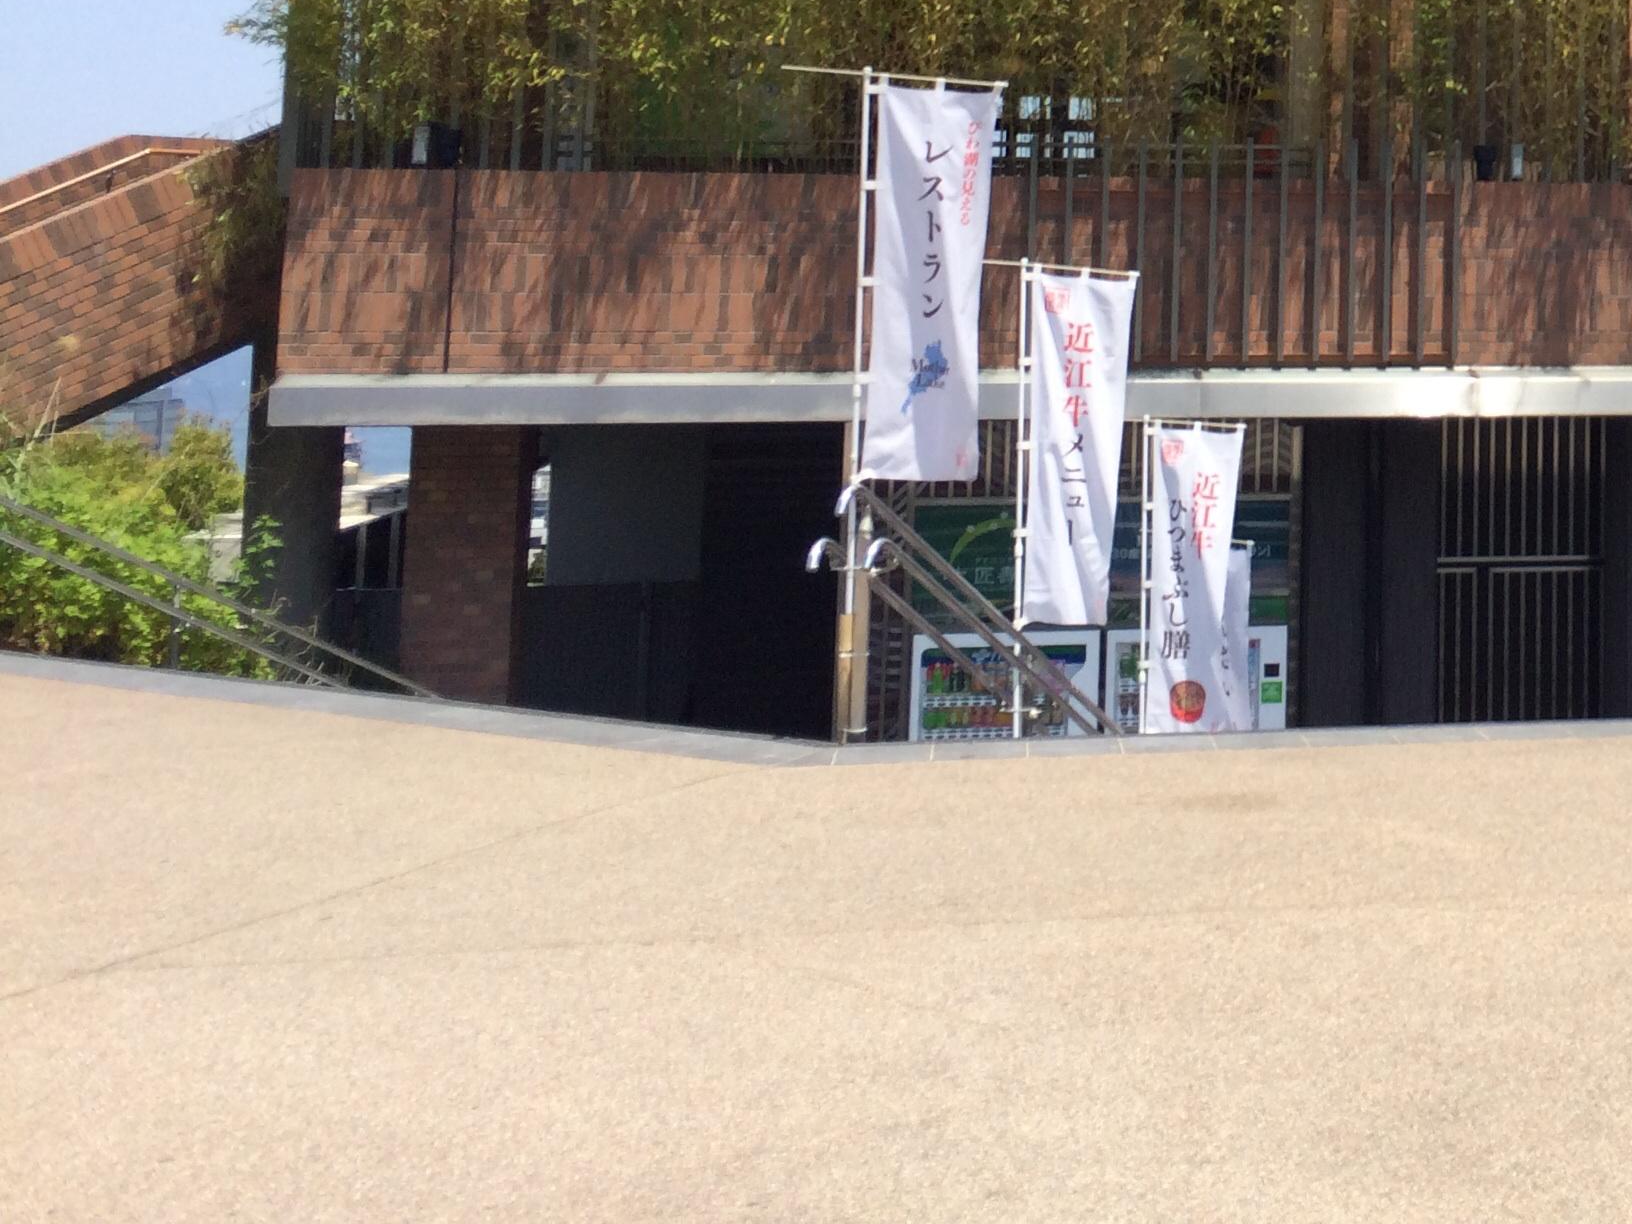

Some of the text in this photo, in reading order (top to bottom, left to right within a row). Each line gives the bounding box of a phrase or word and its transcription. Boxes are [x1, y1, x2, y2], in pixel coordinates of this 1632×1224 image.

[917, 139, 954, 319] レストラン
[960, 120, 983, 227] びわ湖の見える
[1162, 499, 1190, 661] ひつまぶし膳
[1190, 472, 1221, 561] 近江牛
